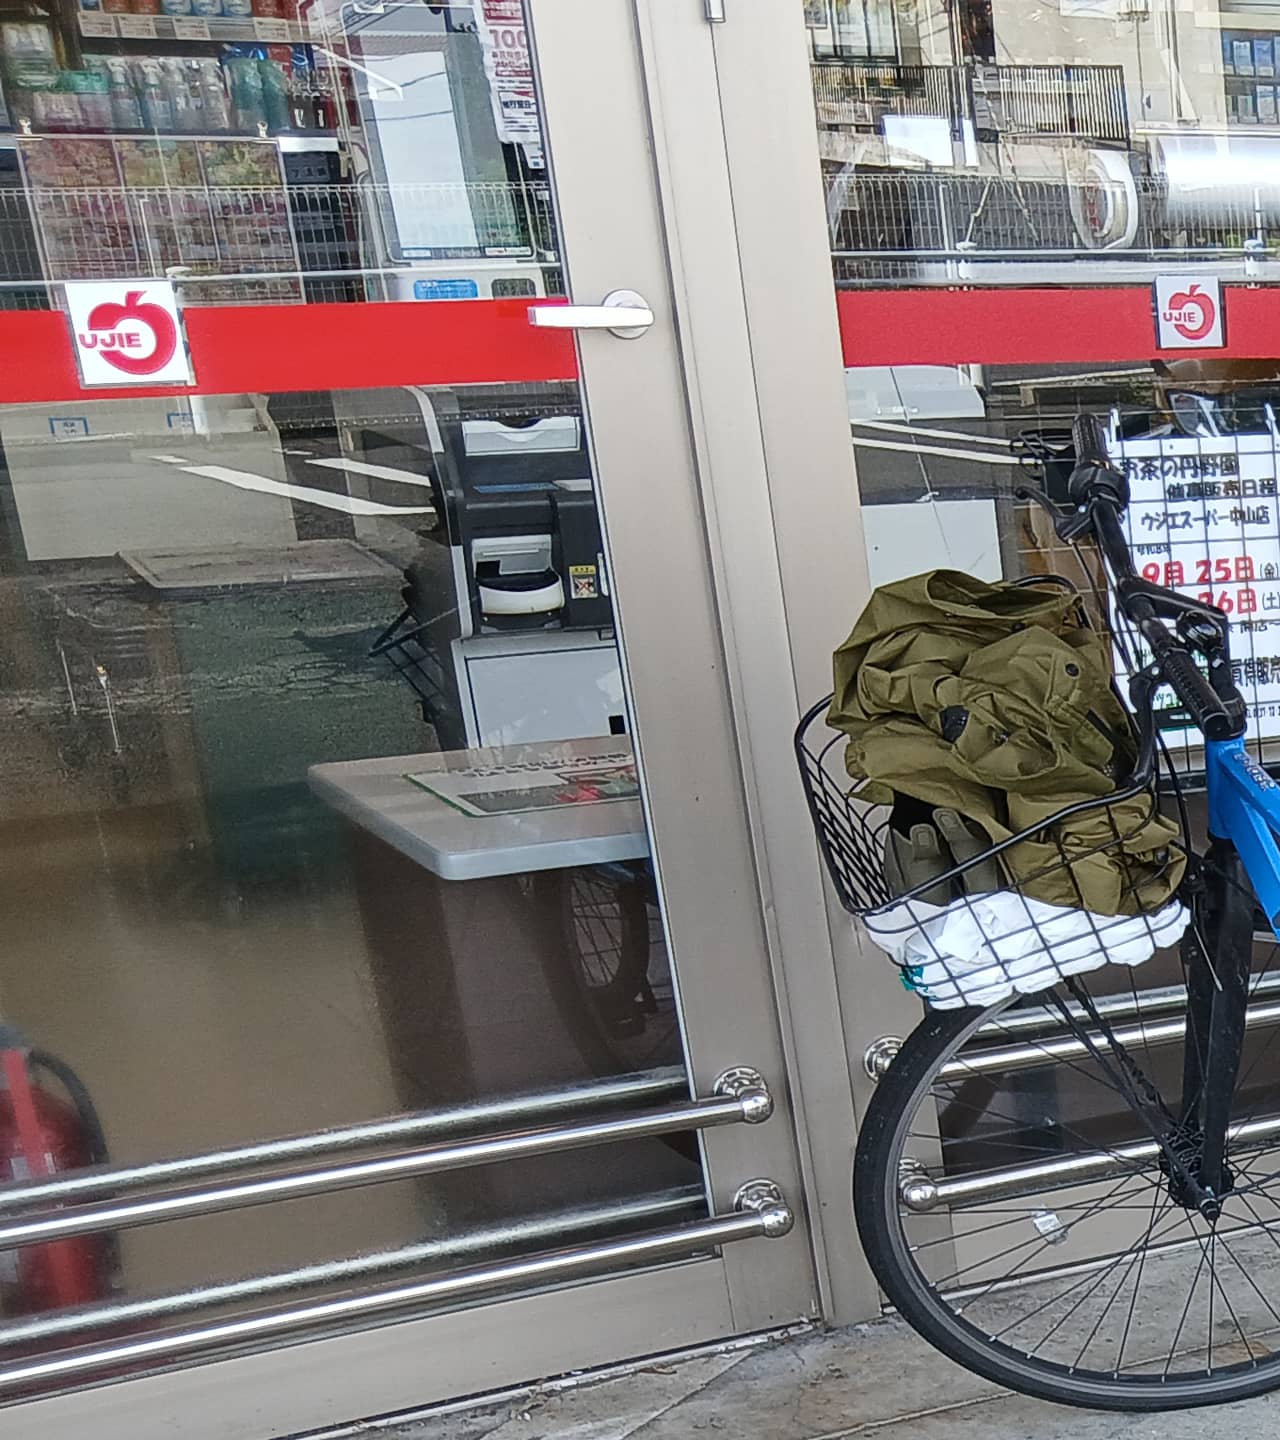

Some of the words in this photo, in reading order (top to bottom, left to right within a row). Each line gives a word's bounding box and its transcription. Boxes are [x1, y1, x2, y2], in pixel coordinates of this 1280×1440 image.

[1162, 311, 1197, 323] UJIE
[78, 332, 143, 349] UJIE
[1195, 555, 1255, 586] 25日
